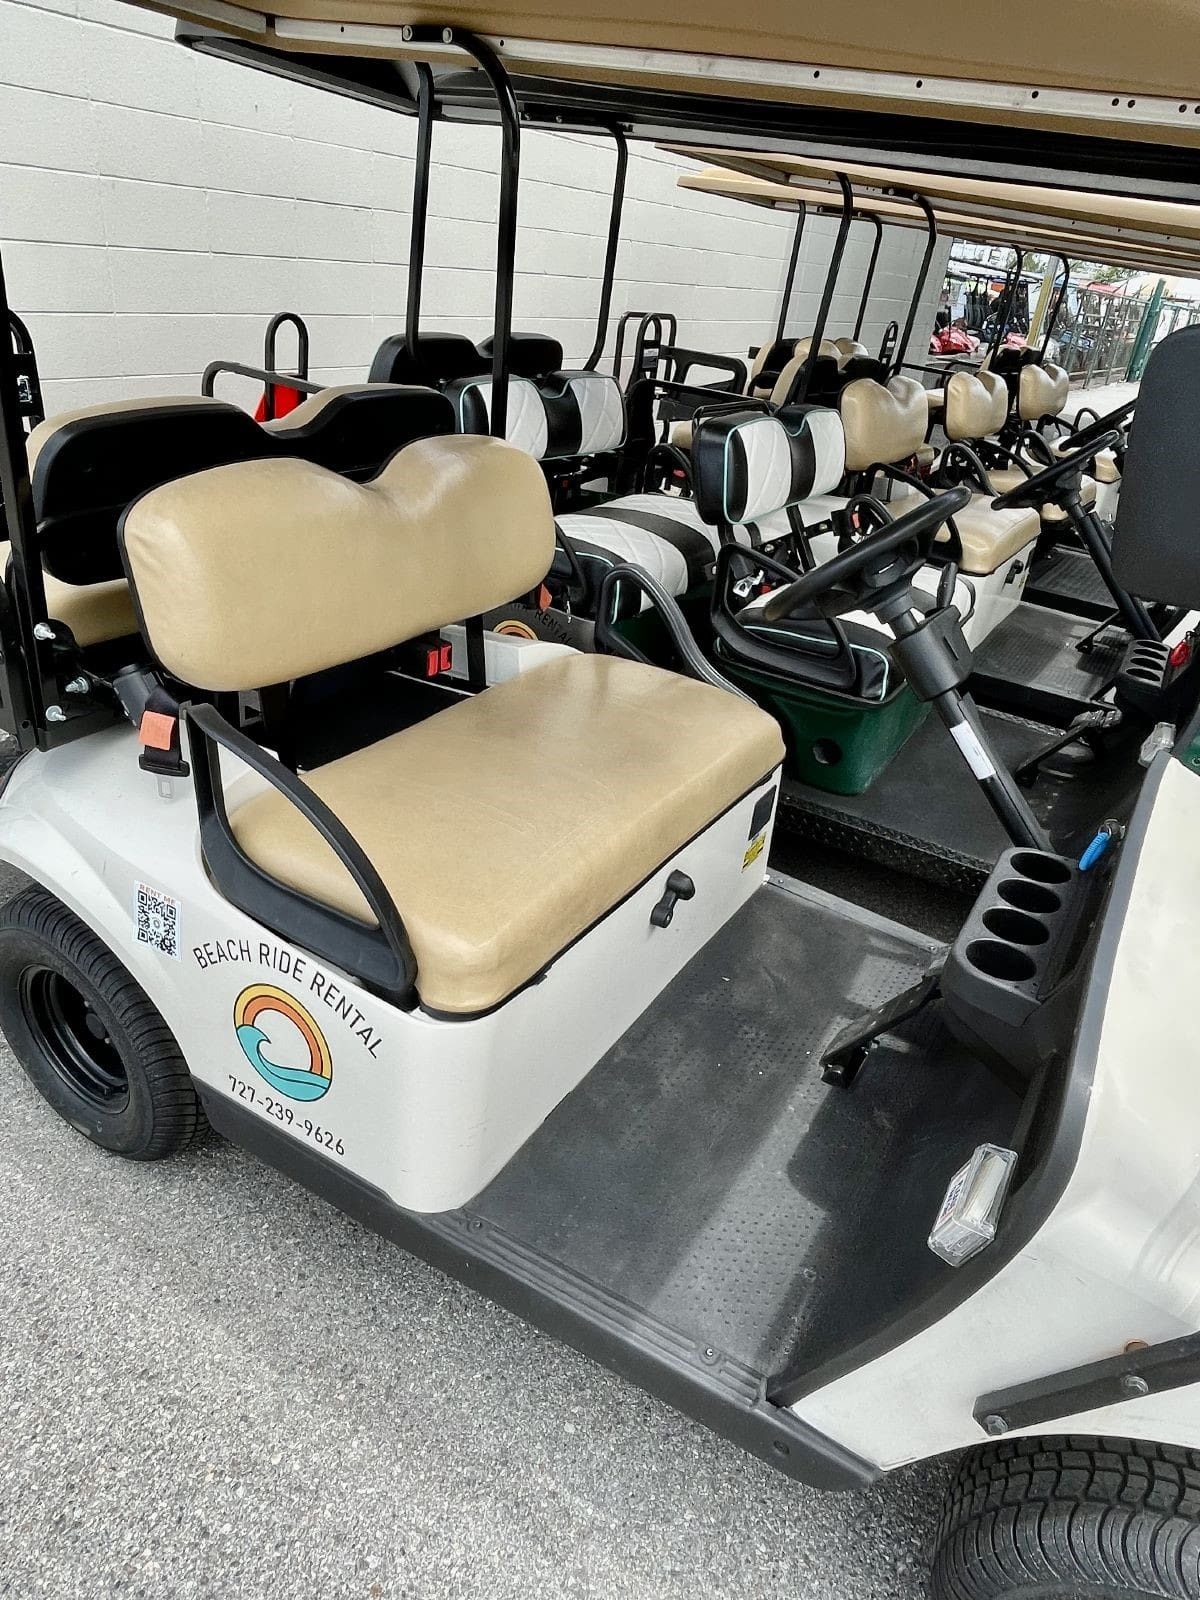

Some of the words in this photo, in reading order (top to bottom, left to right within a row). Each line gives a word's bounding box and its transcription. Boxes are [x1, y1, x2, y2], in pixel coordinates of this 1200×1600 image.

[139, 883, 161, 898] RENT
[163, 895, 177, 906] ME
[192, 939, 252, 970] BEACH
[258, 942, 307, 983] RIDE
[309, 970, 385, 1060] RENTAL
[228, 1074, 346, 1156] 727-239-9626
